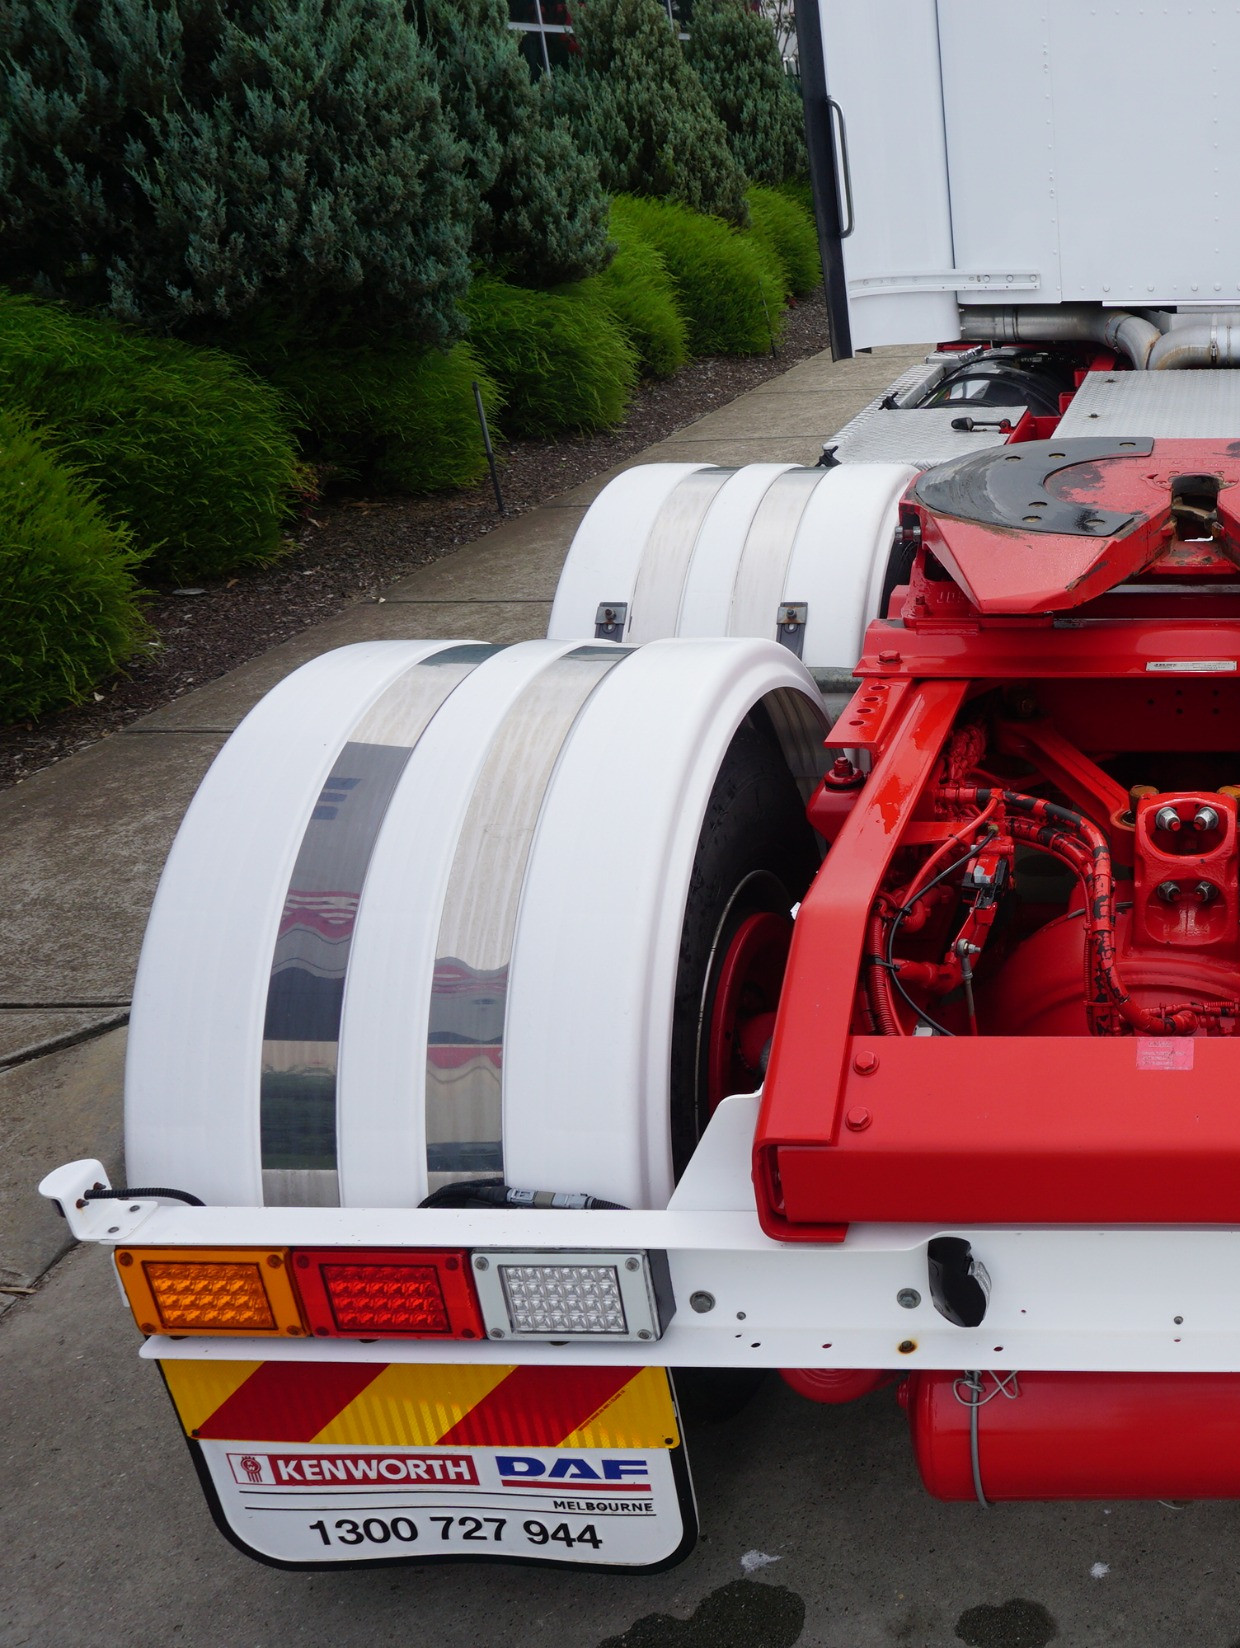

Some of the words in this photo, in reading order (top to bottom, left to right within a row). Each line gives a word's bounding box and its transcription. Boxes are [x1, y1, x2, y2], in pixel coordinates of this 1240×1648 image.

[277, 1459, 471, 1481] KENWORTH
[495, 1456, 649, 1480] DAF
[553, 1500, 654, 1512] MELBOURNE
[309, 1517, 419, 1546] 1300
[429, 1516, 507, 1542] 727
[522, 1519, 603, 1550] 944
